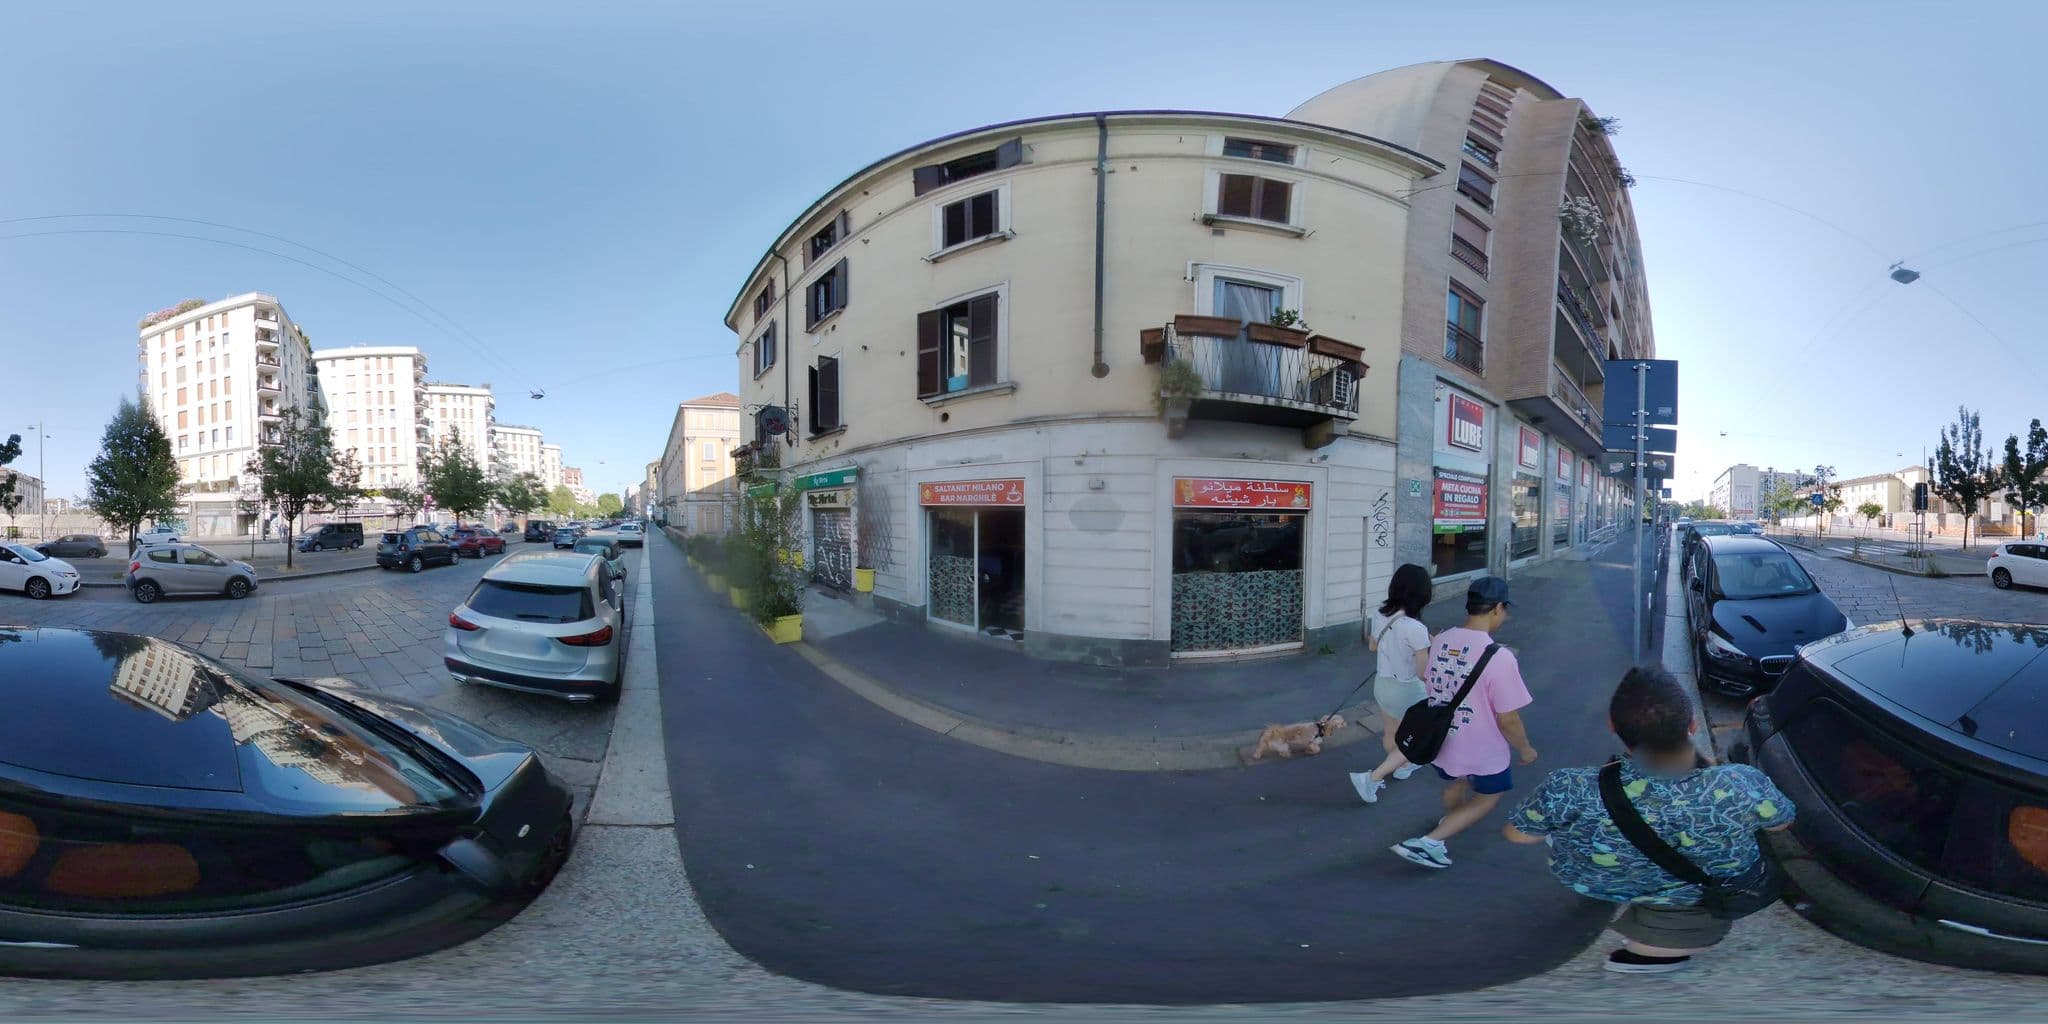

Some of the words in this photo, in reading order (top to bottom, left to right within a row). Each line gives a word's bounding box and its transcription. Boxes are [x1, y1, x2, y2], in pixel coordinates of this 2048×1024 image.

[1455, 417, 1482, 447] LUBE
[934, 484, 972, 494] SALTANET
[972, 483, 1005, 492] MILANO
[1199, 481, 1241, 494] ميلانو
[1246, 482, 1289, 494] سلطنة
[1459, 484, 1482, 495] CUCINA
[940, 494, 955, 502] BAR
[956, 492, 997, 502] NARGHILÈ
[1256, 496, 1277, 507] بار
[1444, 492, 1453, 501] IN
[1454, 494, 1479, 504] REGALO
